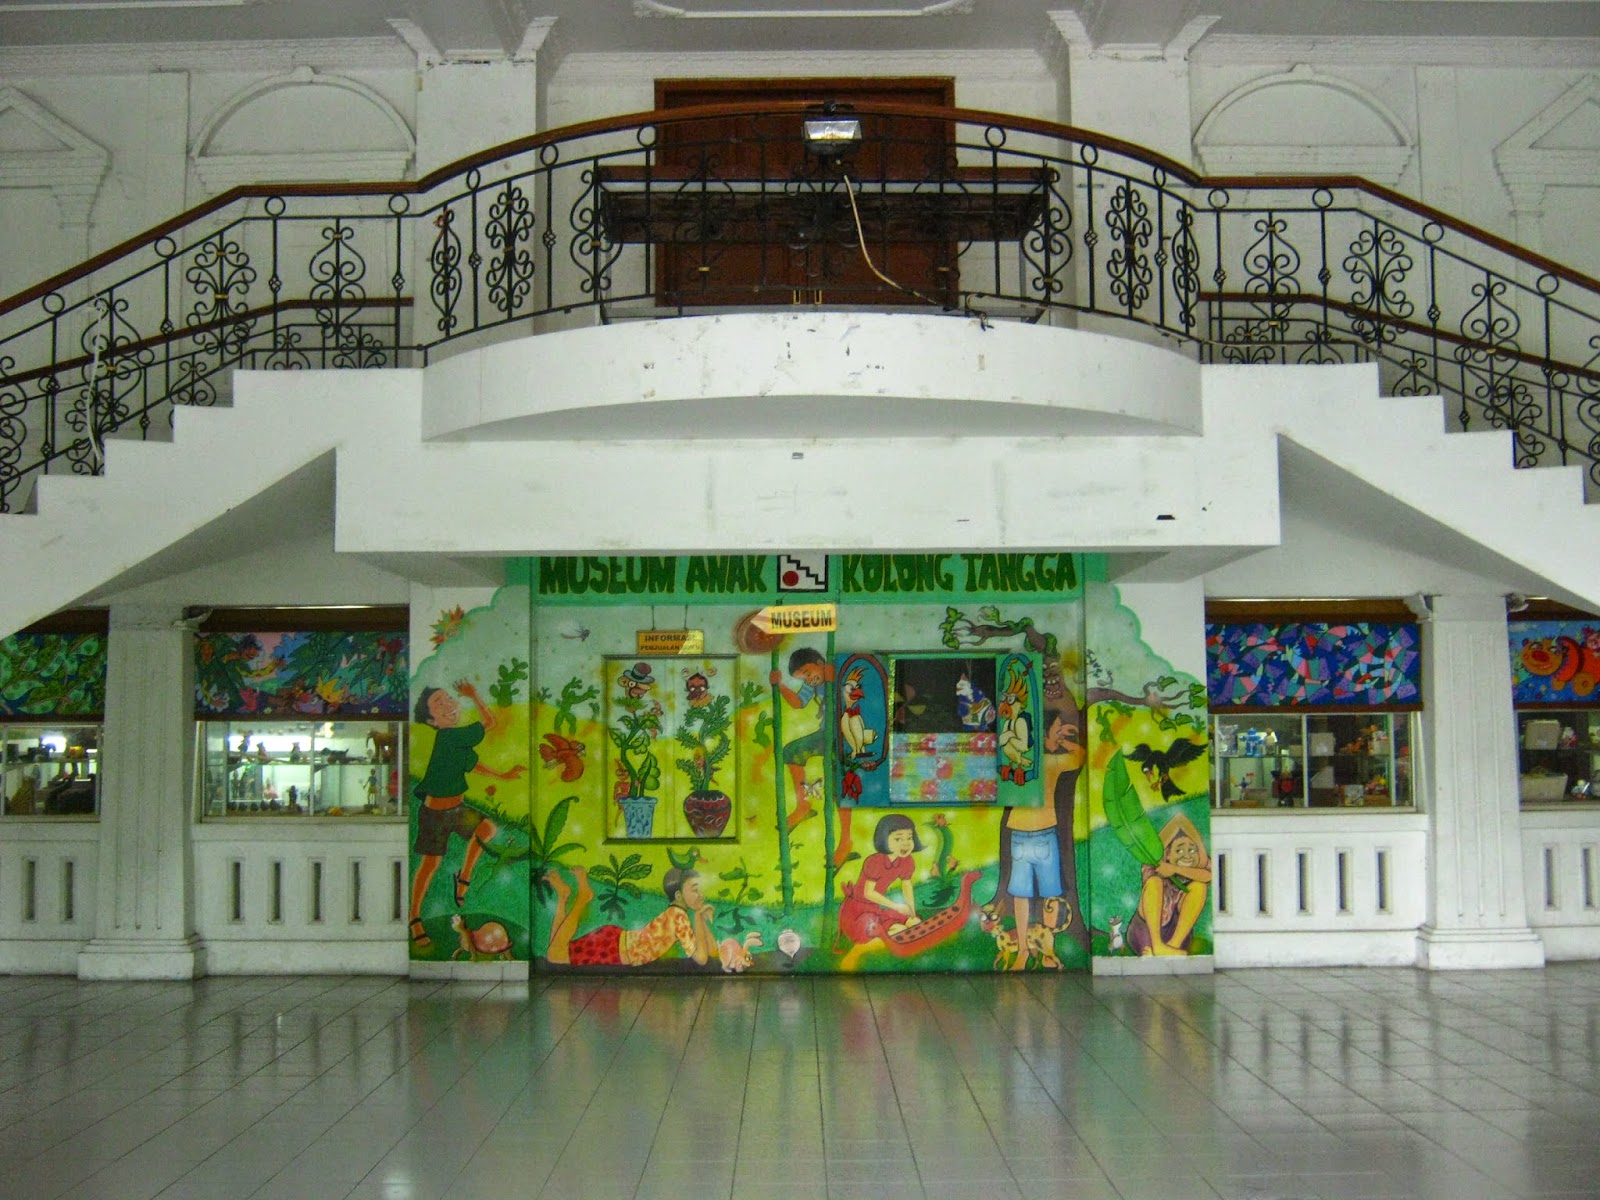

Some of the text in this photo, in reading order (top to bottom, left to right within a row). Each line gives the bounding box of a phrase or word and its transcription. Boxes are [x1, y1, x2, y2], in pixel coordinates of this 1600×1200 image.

[538, 553, 1079, 595] MUSEUM ANAK KOLONG TANGGA
[771, 609, 832, 629] MUSEUM
[644, 634, 695, 642] INFORMA
